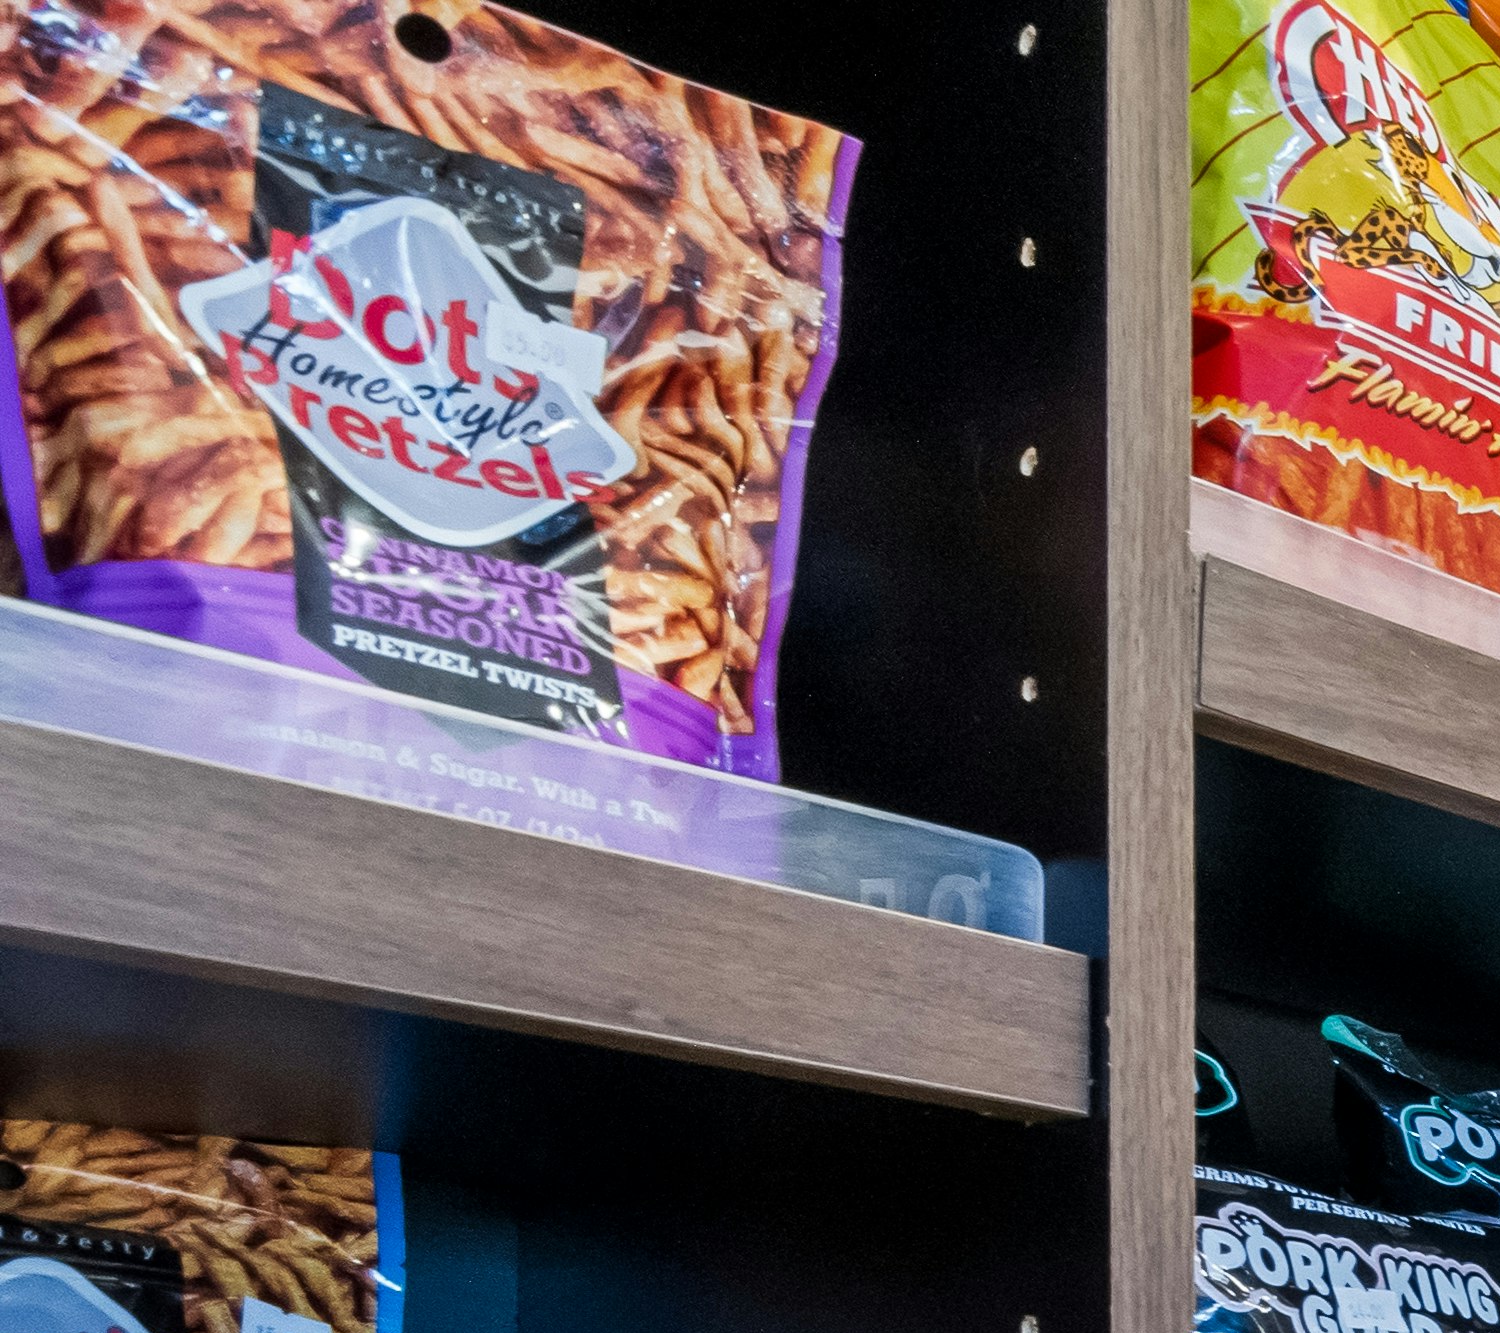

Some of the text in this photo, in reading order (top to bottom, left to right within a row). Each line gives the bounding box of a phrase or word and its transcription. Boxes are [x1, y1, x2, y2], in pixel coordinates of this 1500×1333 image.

[221, 330, 617, 500] Pretzels
[240, 310, 552, 447] Homestyle
[1307, 341, 1491, 443] Flamin'
[331, 584, 592, 675] SEASONED
[331, 624, 597, 708] PRETZEL TWISTS
[55, 1235, 157, 1260] zesty
[1292, 1196, 1330, 1213] PER
[1201, 1227, 1500, 1325] PORK KING
